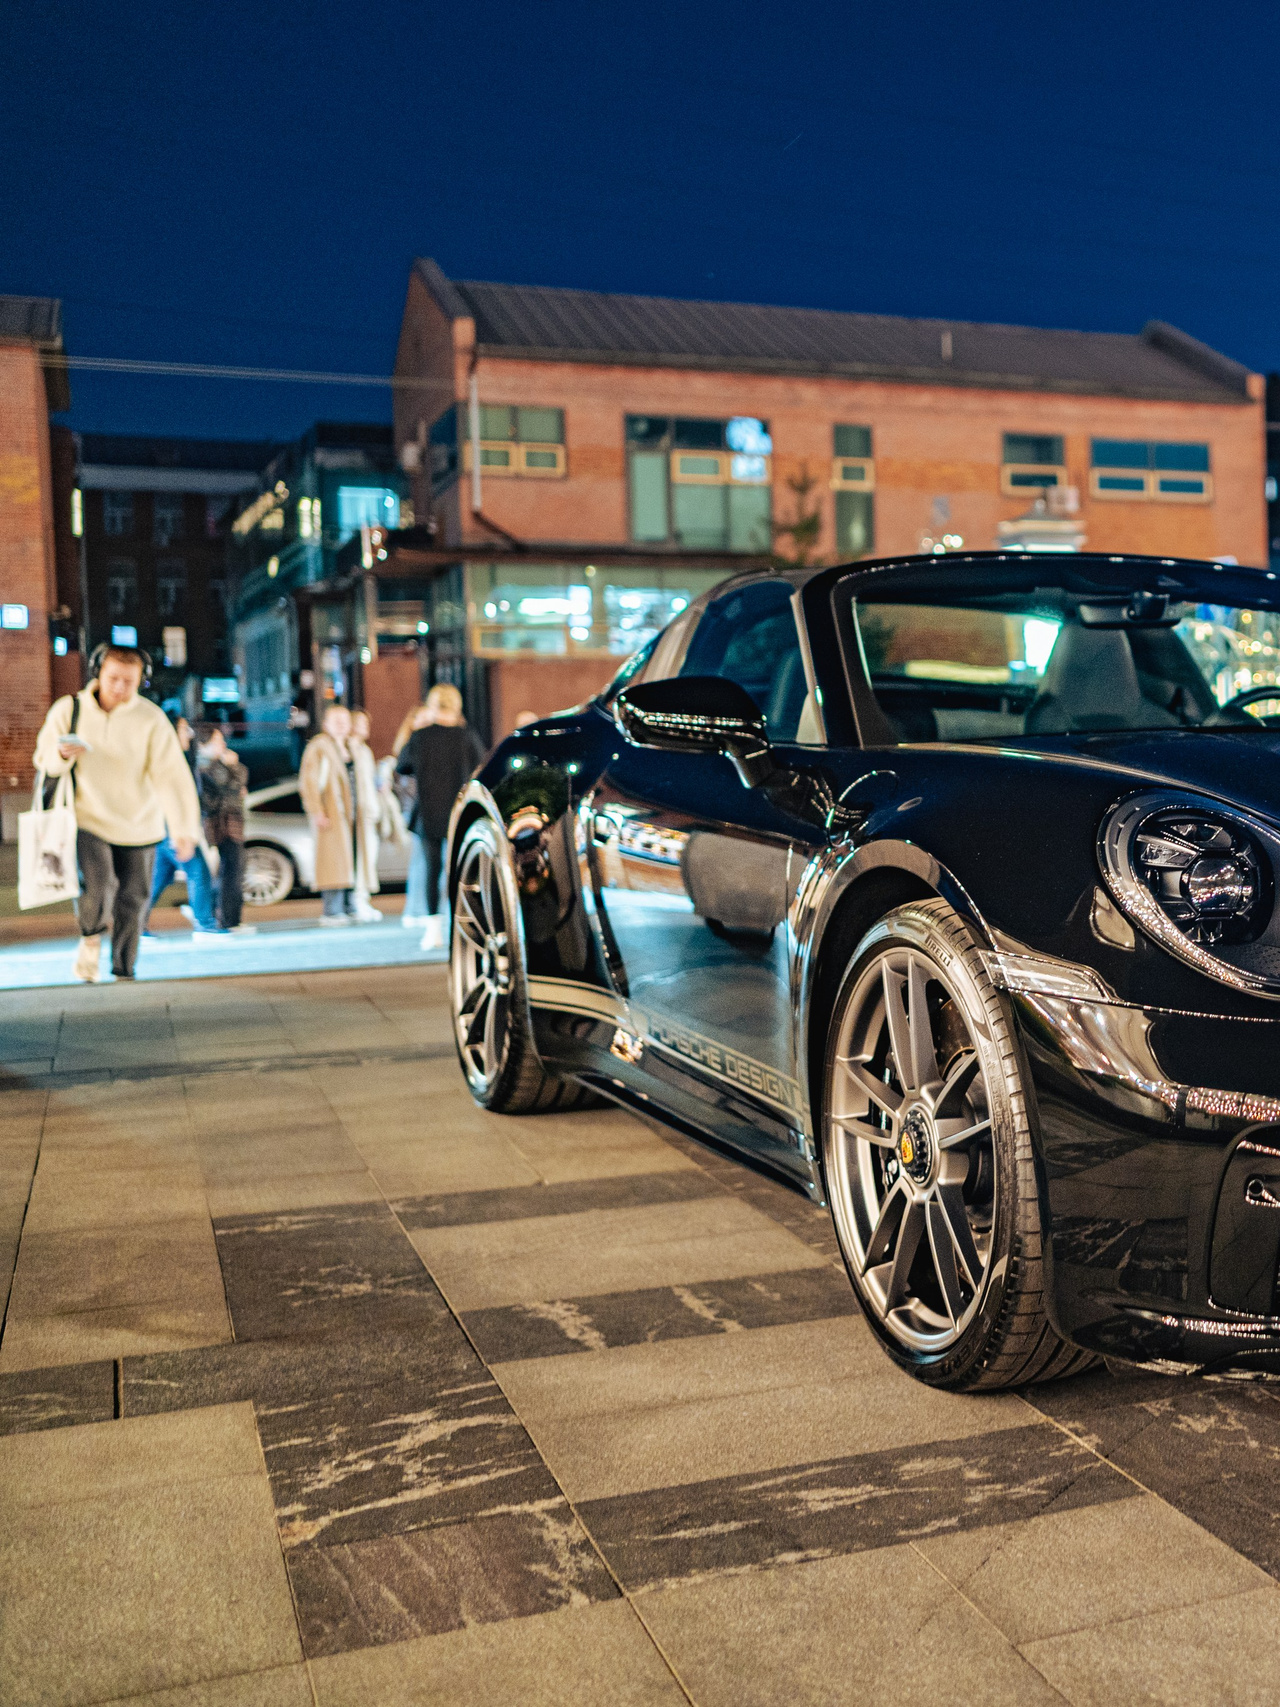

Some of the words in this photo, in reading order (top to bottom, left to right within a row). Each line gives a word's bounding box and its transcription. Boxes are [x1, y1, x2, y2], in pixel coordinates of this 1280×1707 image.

[925, 932, 953, 967] PIRELLI
[651, 1023, 722, 1071] PORSCHE
[725, 1053, 796, 1109] DESIGN
